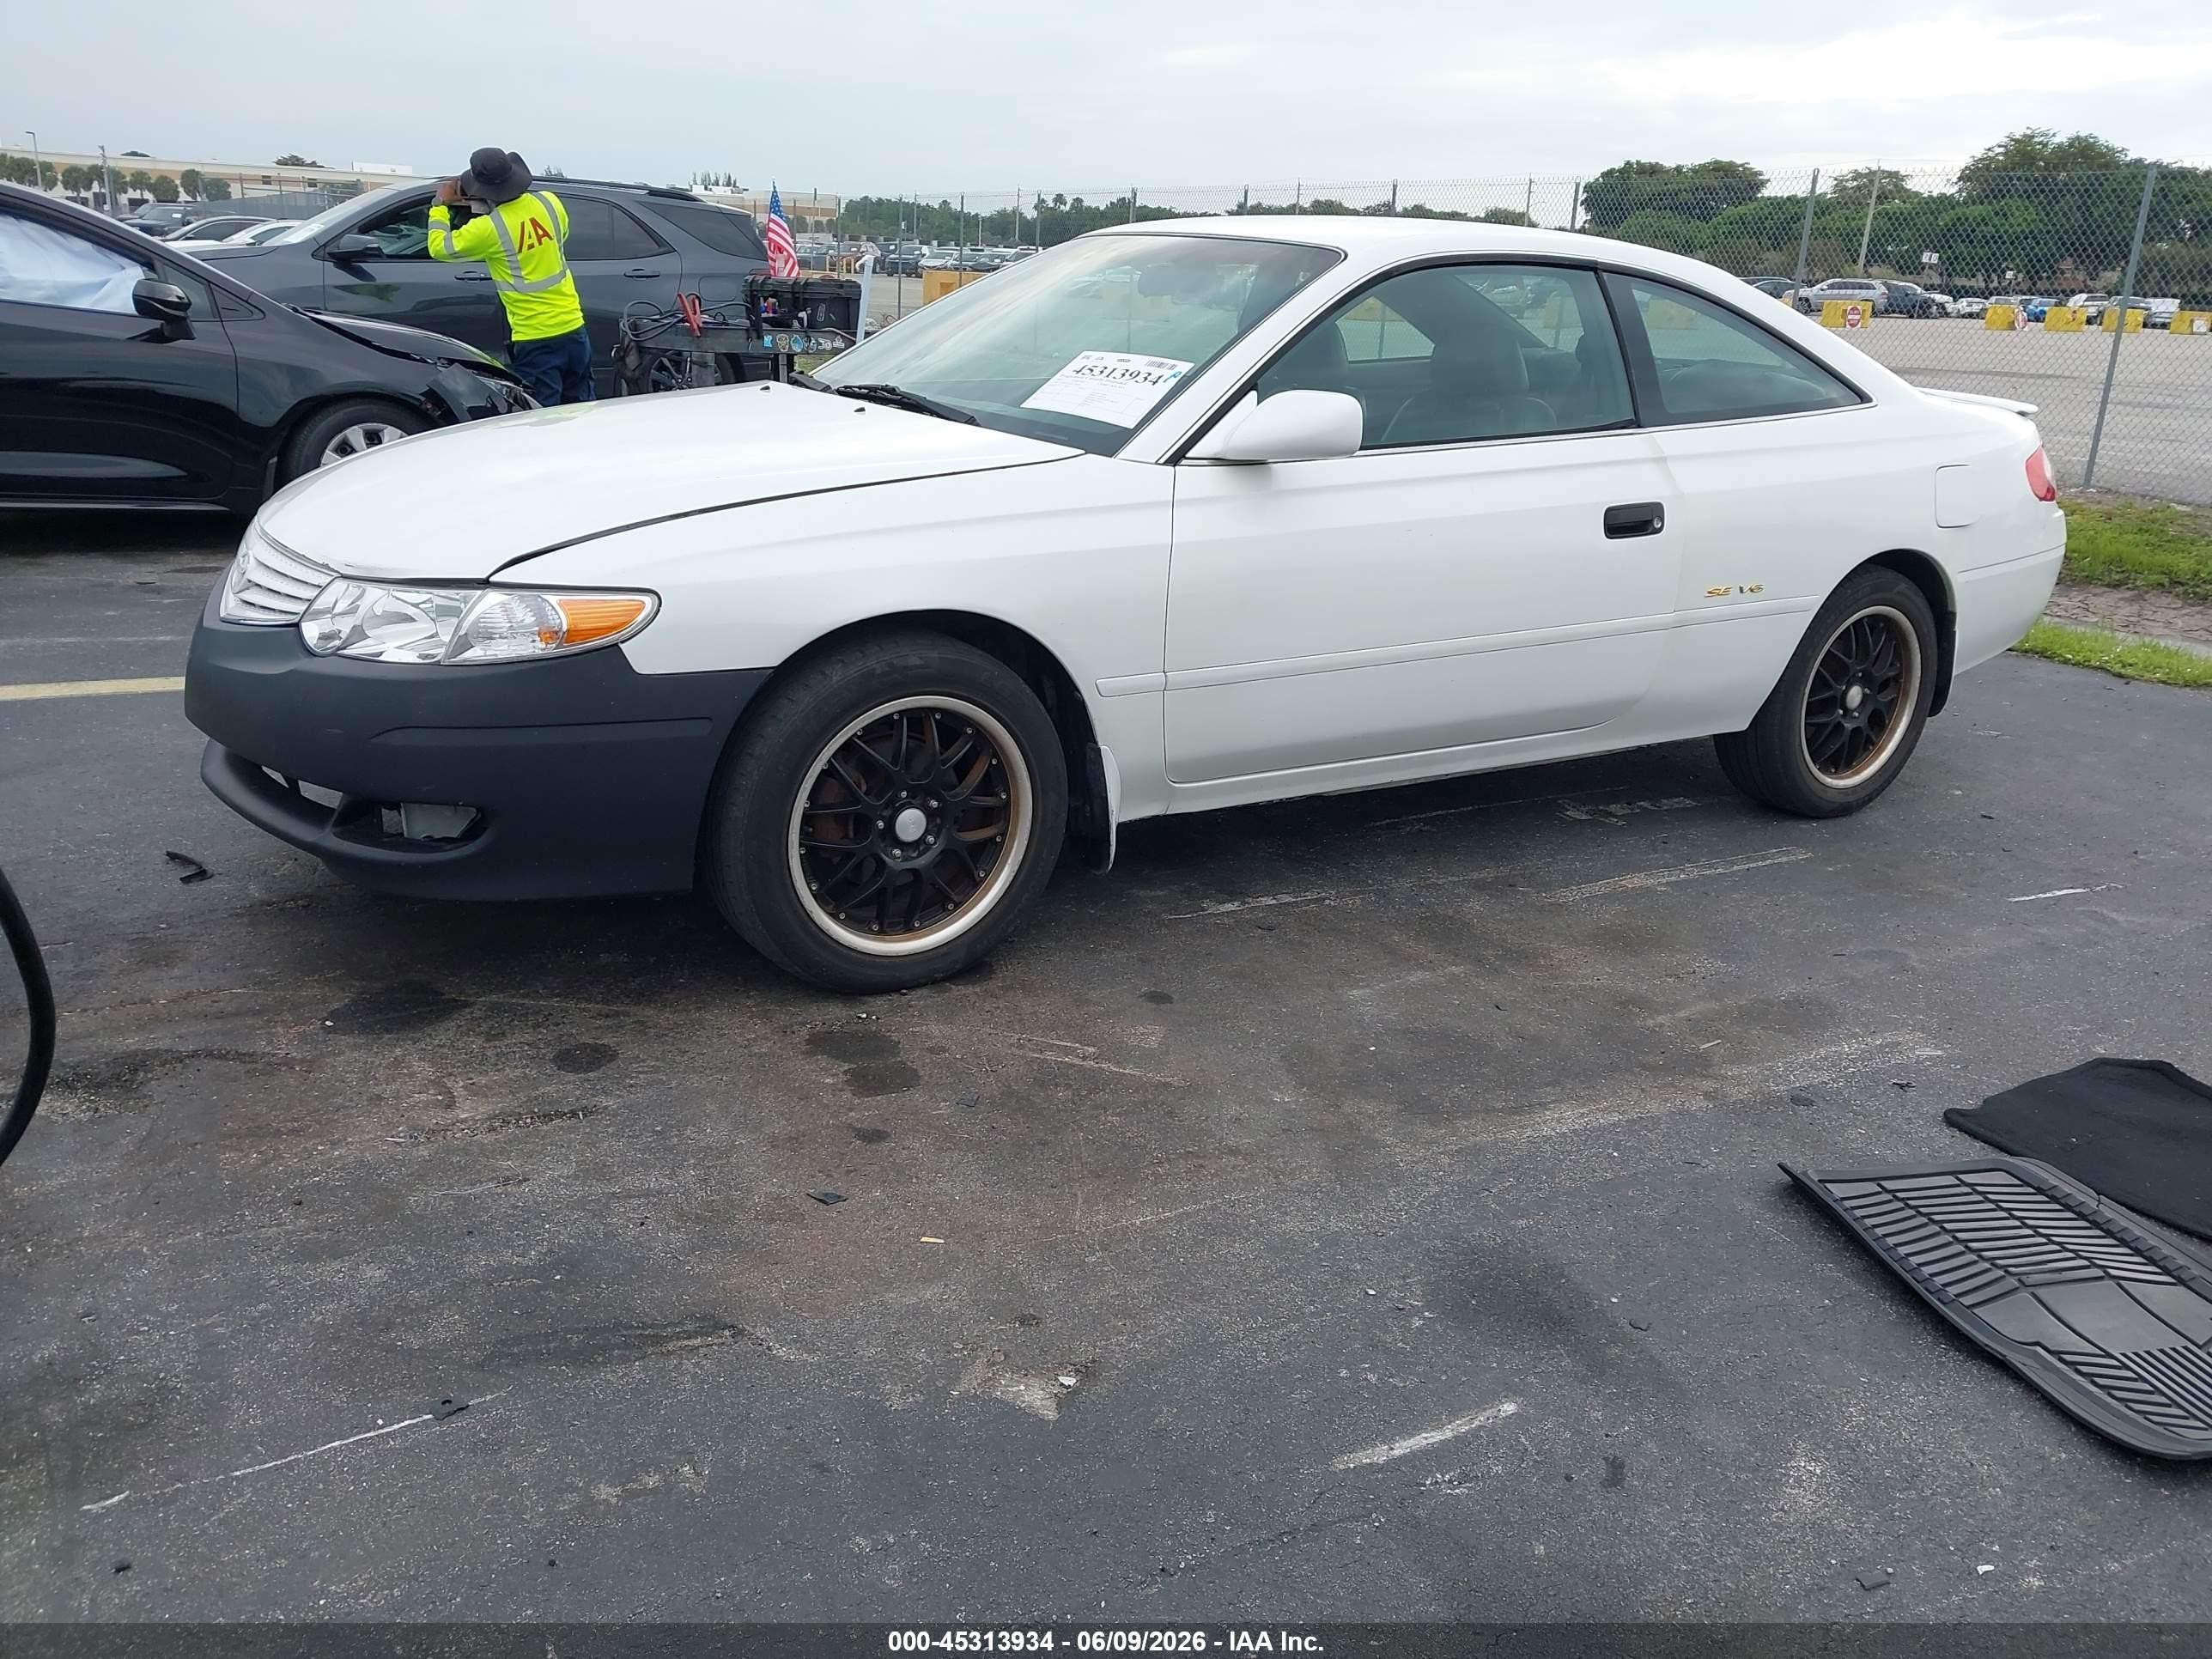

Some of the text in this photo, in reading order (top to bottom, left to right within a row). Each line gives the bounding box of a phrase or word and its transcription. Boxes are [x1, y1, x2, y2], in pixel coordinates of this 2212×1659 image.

[1073, 364, 1164, 386] 45313934
[1705, 583, 1765, 597] SE V6
